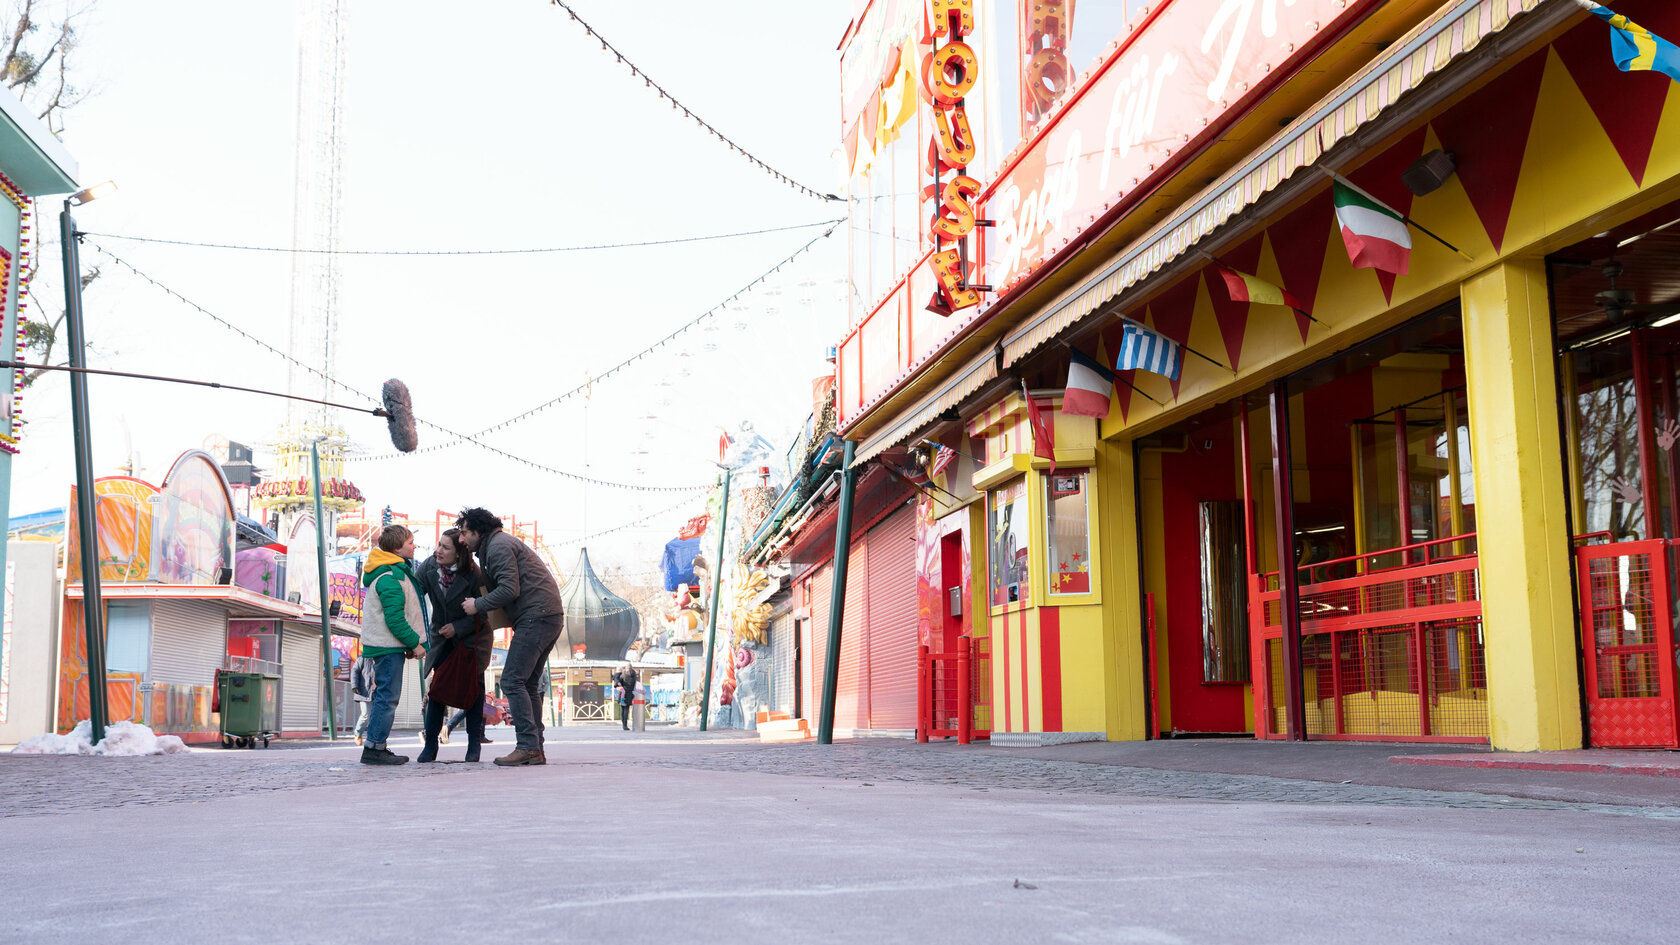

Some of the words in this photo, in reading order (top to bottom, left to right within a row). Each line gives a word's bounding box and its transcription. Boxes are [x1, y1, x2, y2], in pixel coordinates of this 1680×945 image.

[995, 130, 1082, 287] Spaß
[1101, 52, 1180, 191] für
[1194, 187, 1240, 236] CALYPSO
